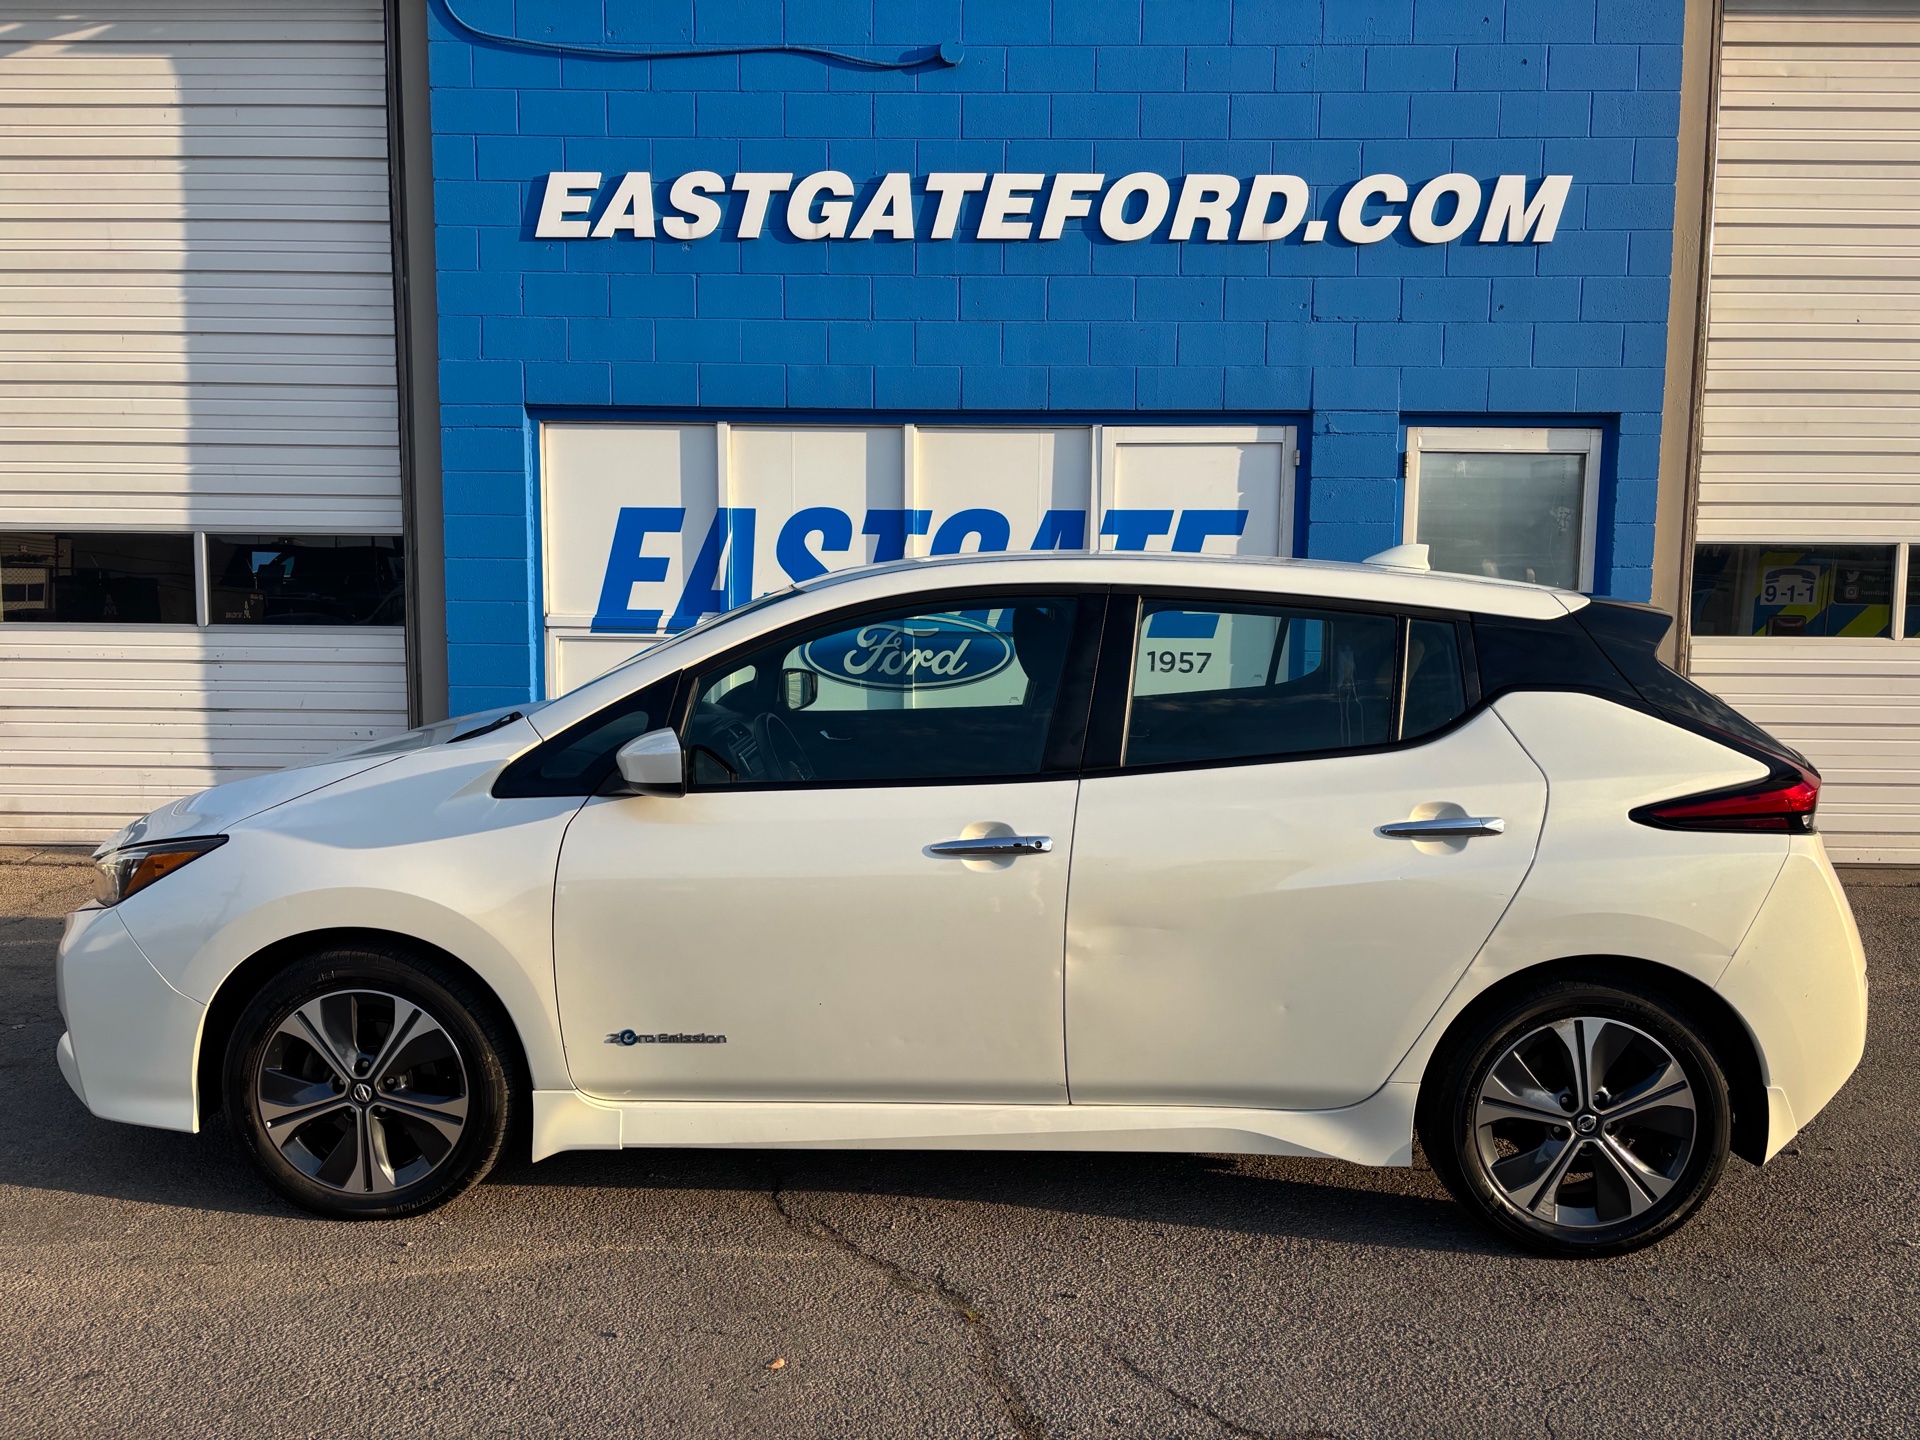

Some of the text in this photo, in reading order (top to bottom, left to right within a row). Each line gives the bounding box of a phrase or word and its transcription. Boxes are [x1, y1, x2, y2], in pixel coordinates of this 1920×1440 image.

[535, 170, 1573, 244] EASTGATEFORD.COM
[1764, 585, 1815, 603] 9-1-1
[843, 624, 972, 676] Ford
[1146, 650, 1213, 674] 1957
[606, 1029, 728, 1046] Zero Emission
